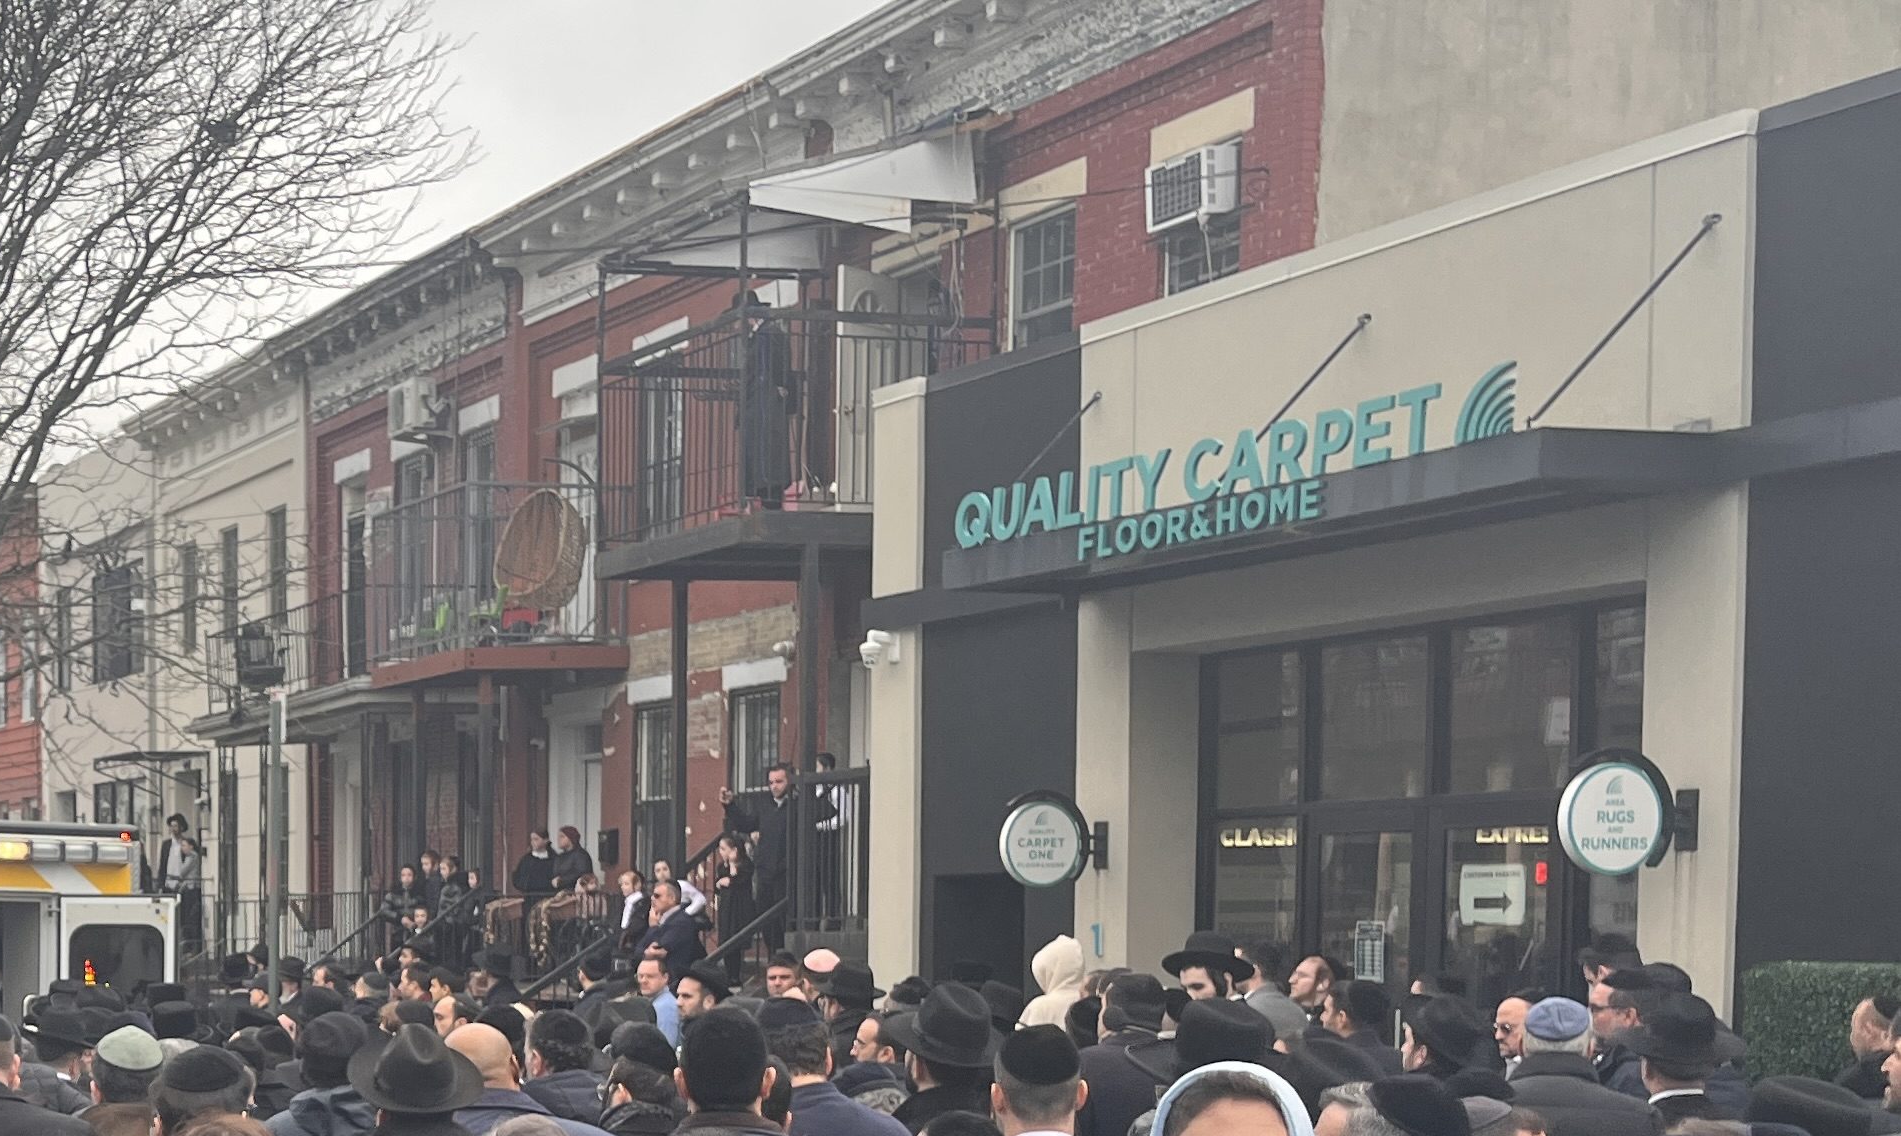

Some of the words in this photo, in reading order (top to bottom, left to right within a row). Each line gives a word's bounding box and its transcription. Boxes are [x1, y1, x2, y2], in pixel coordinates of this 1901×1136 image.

[954, 447, 1172, 550] QUALITY
[1182, 382, 1443, 502] CARPET
[1077, 479, 1324, 562] FLOOR&HOME
[1596, 810, 1635, 824] RUGS
[1017, 837, 1065, 849] CARPET
[1220, 827, 1297, 847] CLASSI
[1581, 837, 1648, 851] RUNNERS
[1028, 849, 1054, 861] ONE
